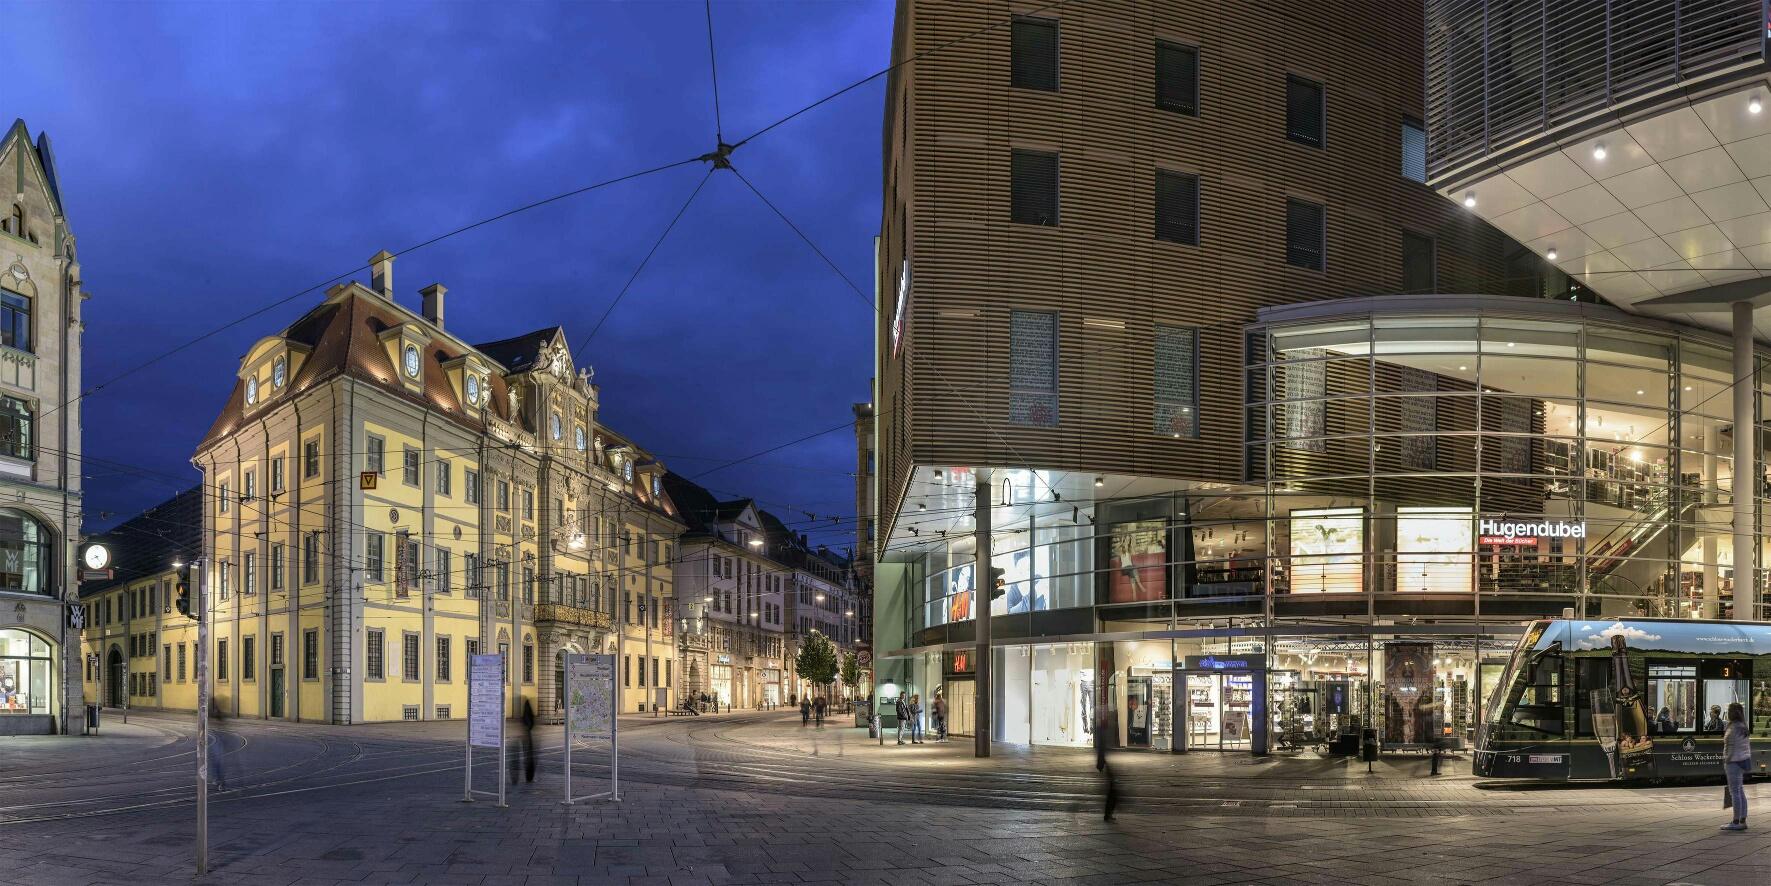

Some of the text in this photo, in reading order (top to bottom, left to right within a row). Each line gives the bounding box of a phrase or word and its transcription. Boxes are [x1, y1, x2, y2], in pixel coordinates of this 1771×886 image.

[1480, 520, 1586, 539] Hugendubel
[71, 605, 84, 629] WMF
[1724, 668, 1729, 677] 3
[1507, 755, 1521, 763] 718
